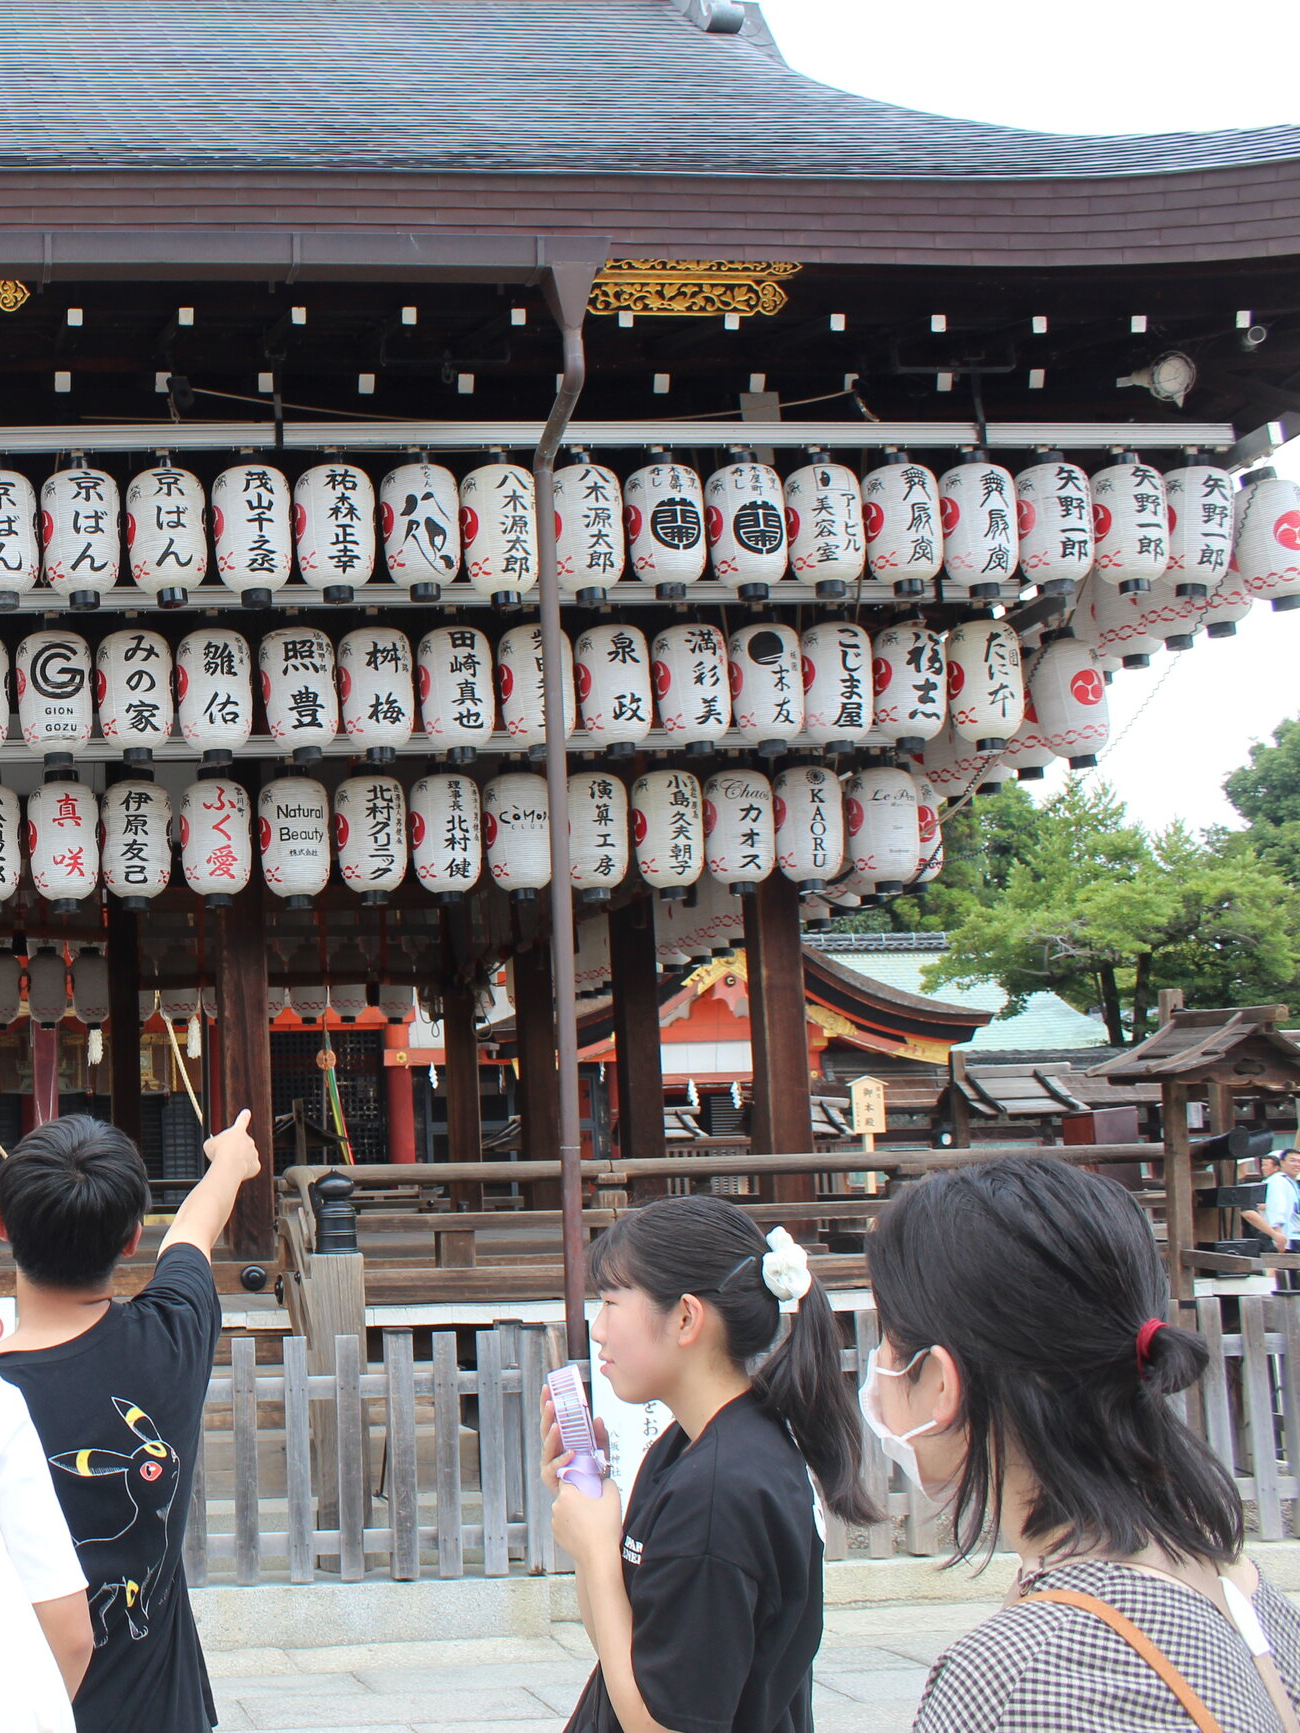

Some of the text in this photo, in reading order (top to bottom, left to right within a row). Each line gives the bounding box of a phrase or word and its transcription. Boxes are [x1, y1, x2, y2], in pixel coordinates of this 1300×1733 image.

[67, 471, 108, 573] 京ばん
[151, 469, 193, 568] 京ばん
[241, 471, 277, 574] 茂山千之丞
[322, 468, 362, 575] 祐森正幸
[495, 471, 531, 582] 八木源太郎
[578, 466, 617, 571] 八木源太郎
[749, 466, 763, 496] 木屋町
[840, 492, 862, 553] アービル
[1054, 465, 1090, 562] 矢野一郎
[1130, 465, 1165, 562] 矢野一郎
[1198, 474, 1230, 573] 矢野一郎
[813, 496, 841, 564] 美容室
[45, 706, 74, 716] GION
[124, 635, 162, 732] みの家
[282, 639, 326, 730] 照豊
[366, 642, 406, 724] 桝梅
[447, 631, 484, 730] 田崎真也
[607, 632, 648, 722] 泉政
[684, 629, 724, 725] 満彩美
[770, 664, 796, 724] 末友
[832, 628, 863, 728] こじま屋
[984, 631, 1015, 718] たに本
[45, 723, 78, 733] GOZU
[52, 793, 85, 877] 真咲
[119, 790, 153, 884] 伊原友己
[203, 785, 236, 879] ふく愛
[277, 804, 323, 819] Natural
[280, 826, 324, 843] Beauty
[289, 848, 318, 857] 株式会社
[365, 784, 395, 880] 北村クリニック
[589, 780, 616, 877] 演算工房
[666, 775, 693, 875] 小島久夫朝子
[738, 804, 762, 870] カオス
[809, 789, 828, 867] KAORU
